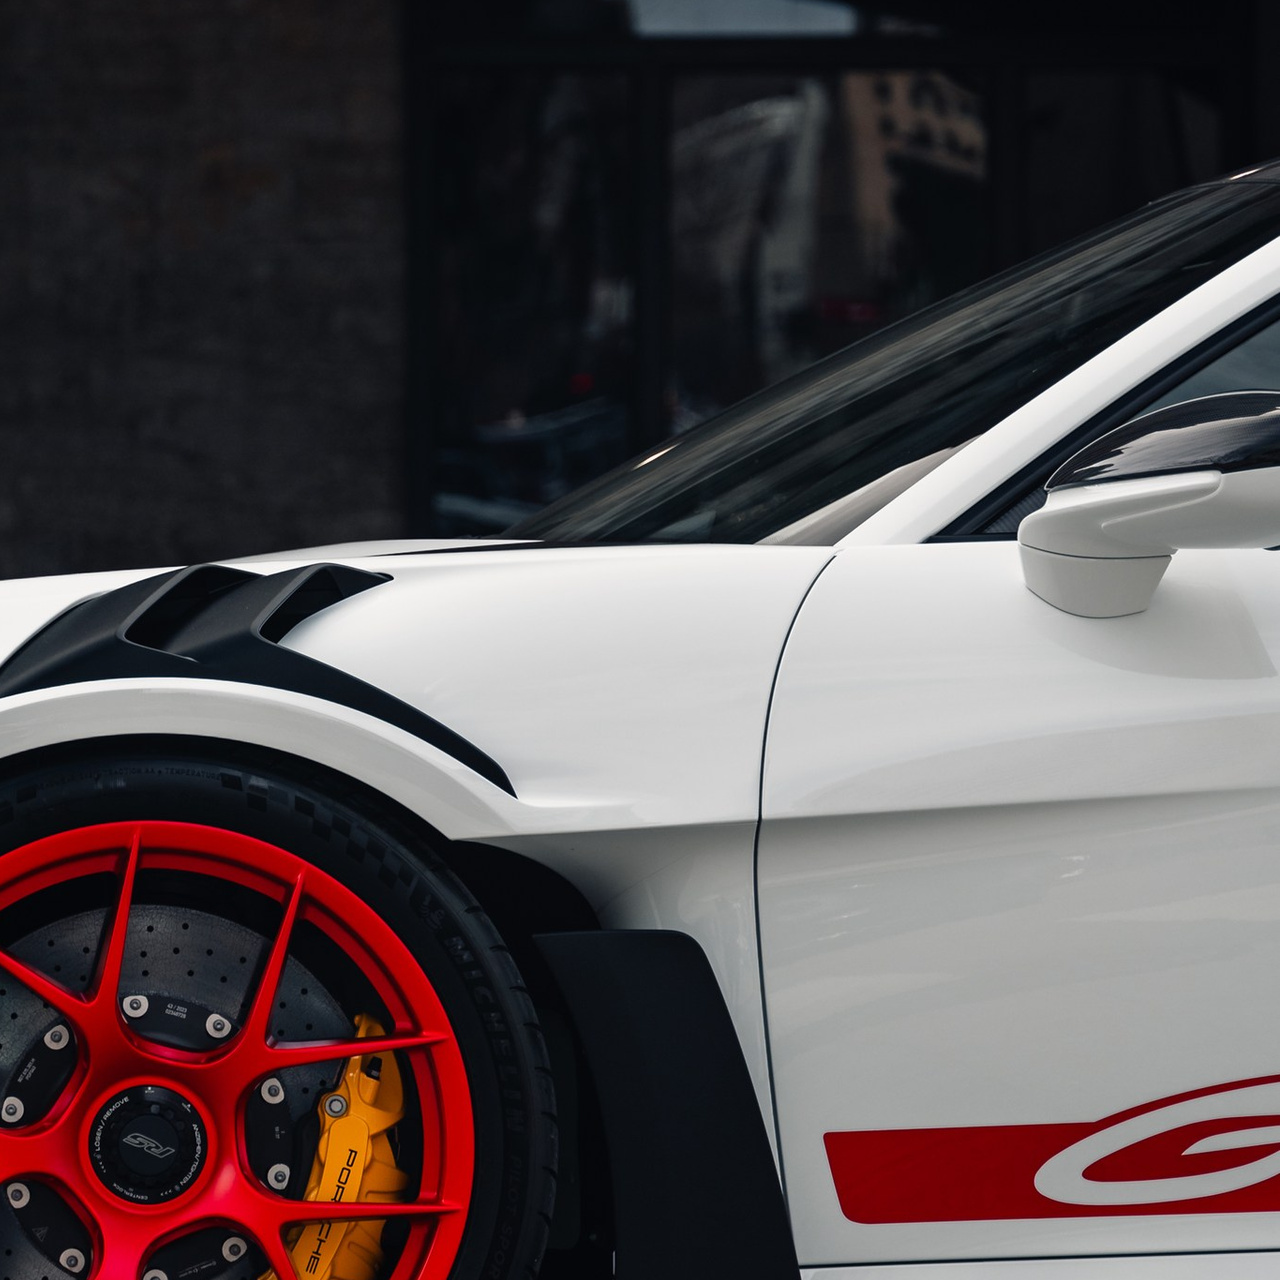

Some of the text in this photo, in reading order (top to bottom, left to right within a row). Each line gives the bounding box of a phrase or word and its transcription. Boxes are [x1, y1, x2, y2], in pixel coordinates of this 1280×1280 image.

[443, 933, 525, 1134] MICHELIN
[102, 1095, 130, 1120] REMOVE
[123, 1132, 175, 1158] RS
[304, 1148, 358, 1275] PORCHE
[503, 1155, 523, 1218] PILOT
